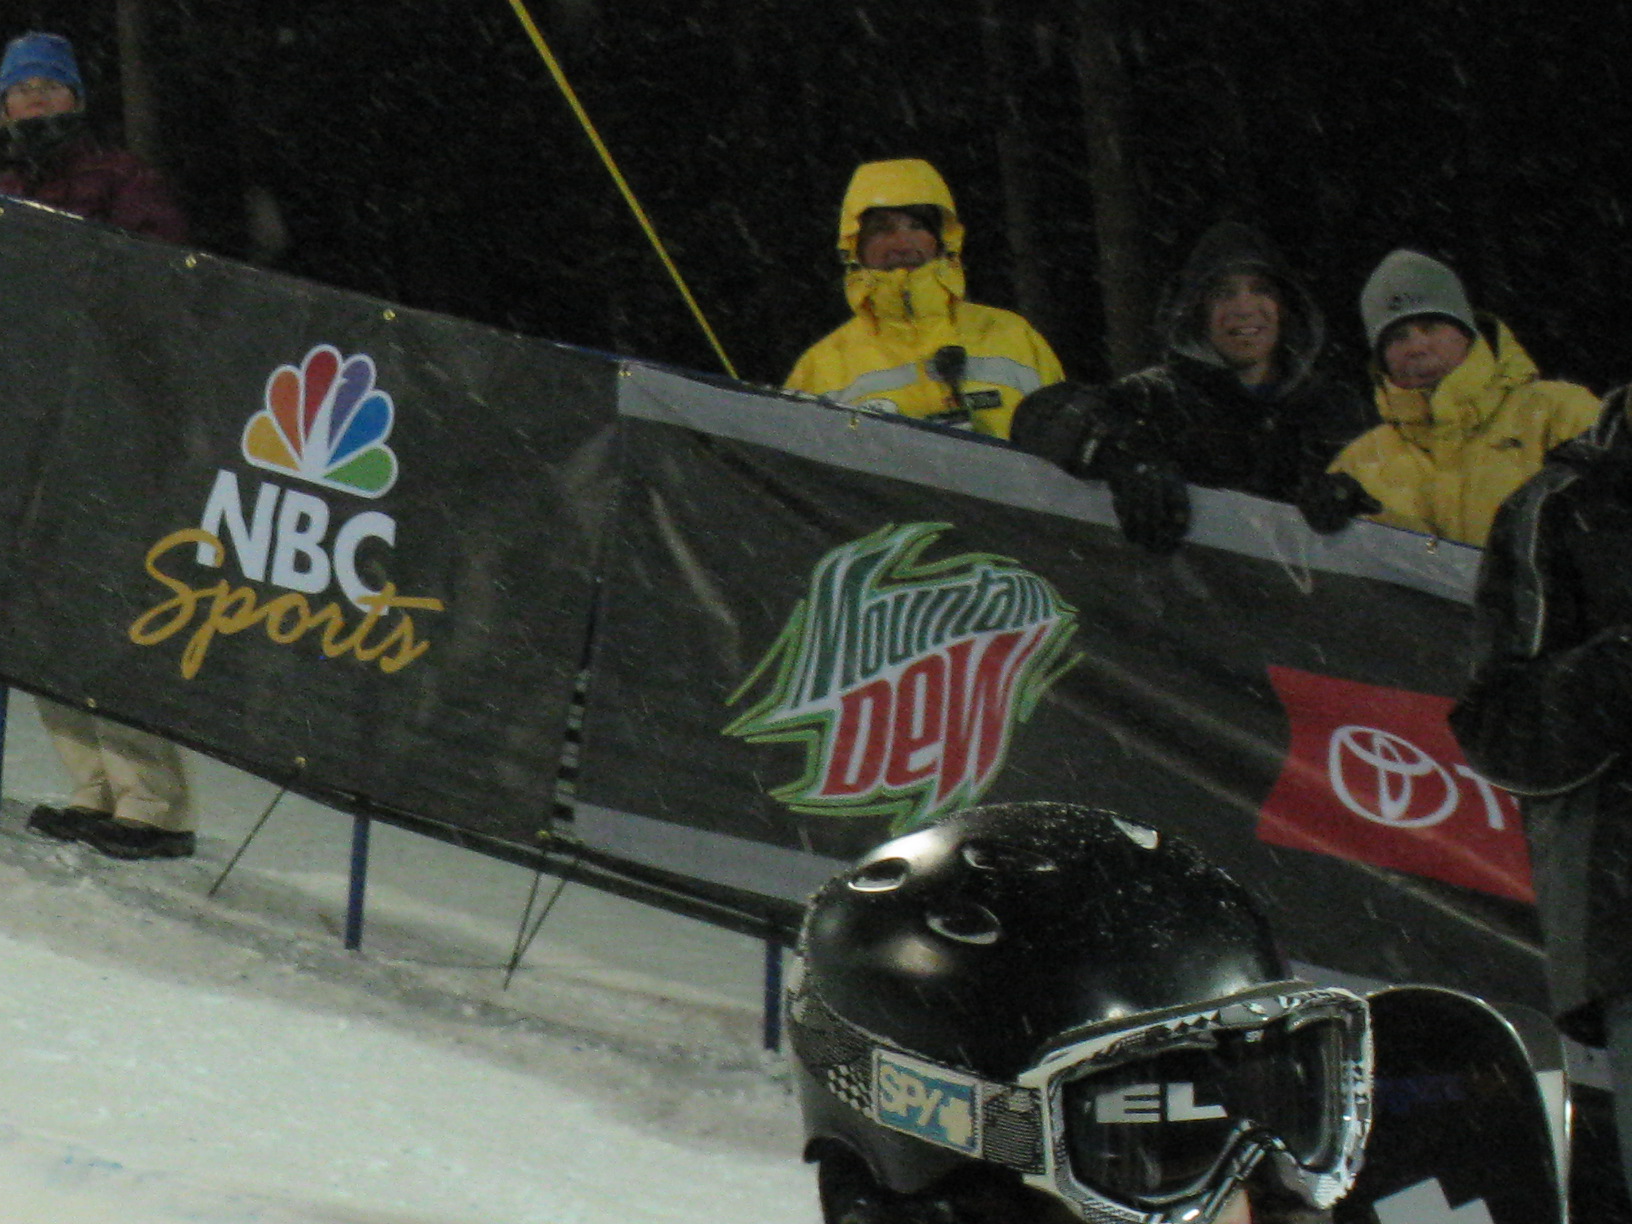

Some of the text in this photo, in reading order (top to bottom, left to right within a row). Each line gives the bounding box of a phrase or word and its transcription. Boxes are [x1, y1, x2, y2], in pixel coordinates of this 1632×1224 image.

[127, 528, 445, 680] Sports
[196, 469, 397, 616] NBC
[788, 530, 1060, 710] Mountain
